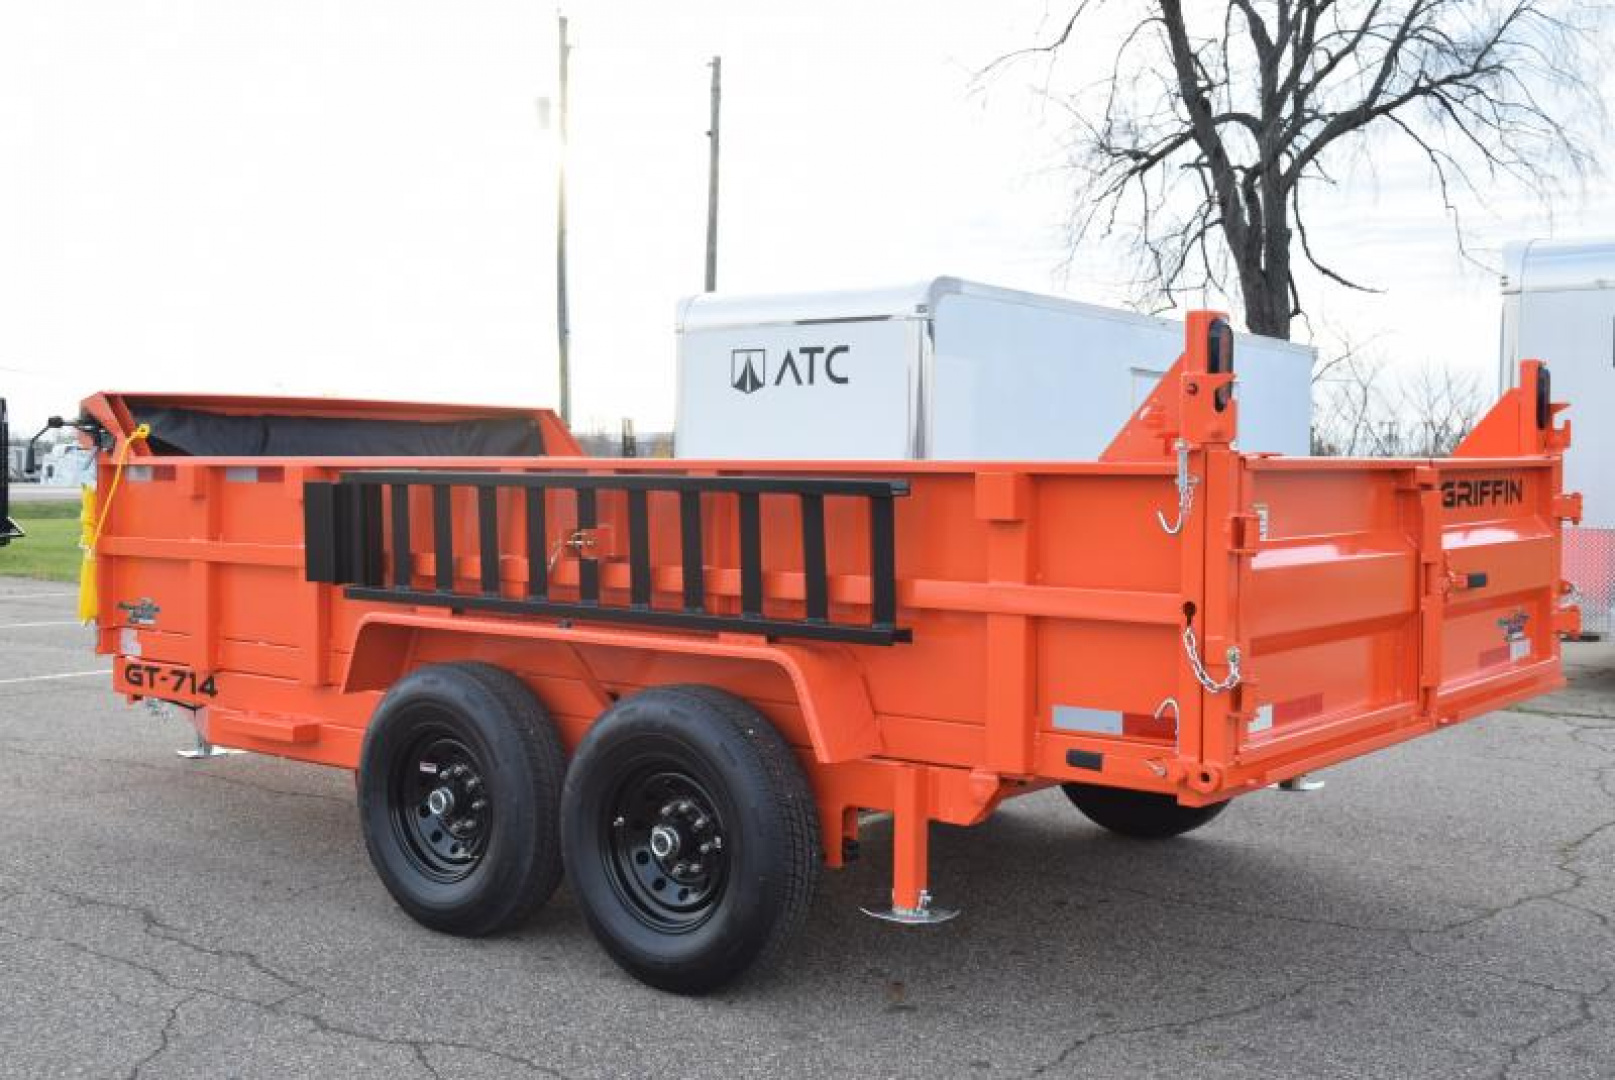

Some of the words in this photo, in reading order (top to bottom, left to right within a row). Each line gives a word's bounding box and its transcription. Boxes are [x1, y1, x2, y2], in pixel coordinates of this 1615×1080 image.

[774, 344, 849, 386] ATC
[1441, 479, 1523, 508] GRIFFIN
[125, 663, 218, 698] GT-714
